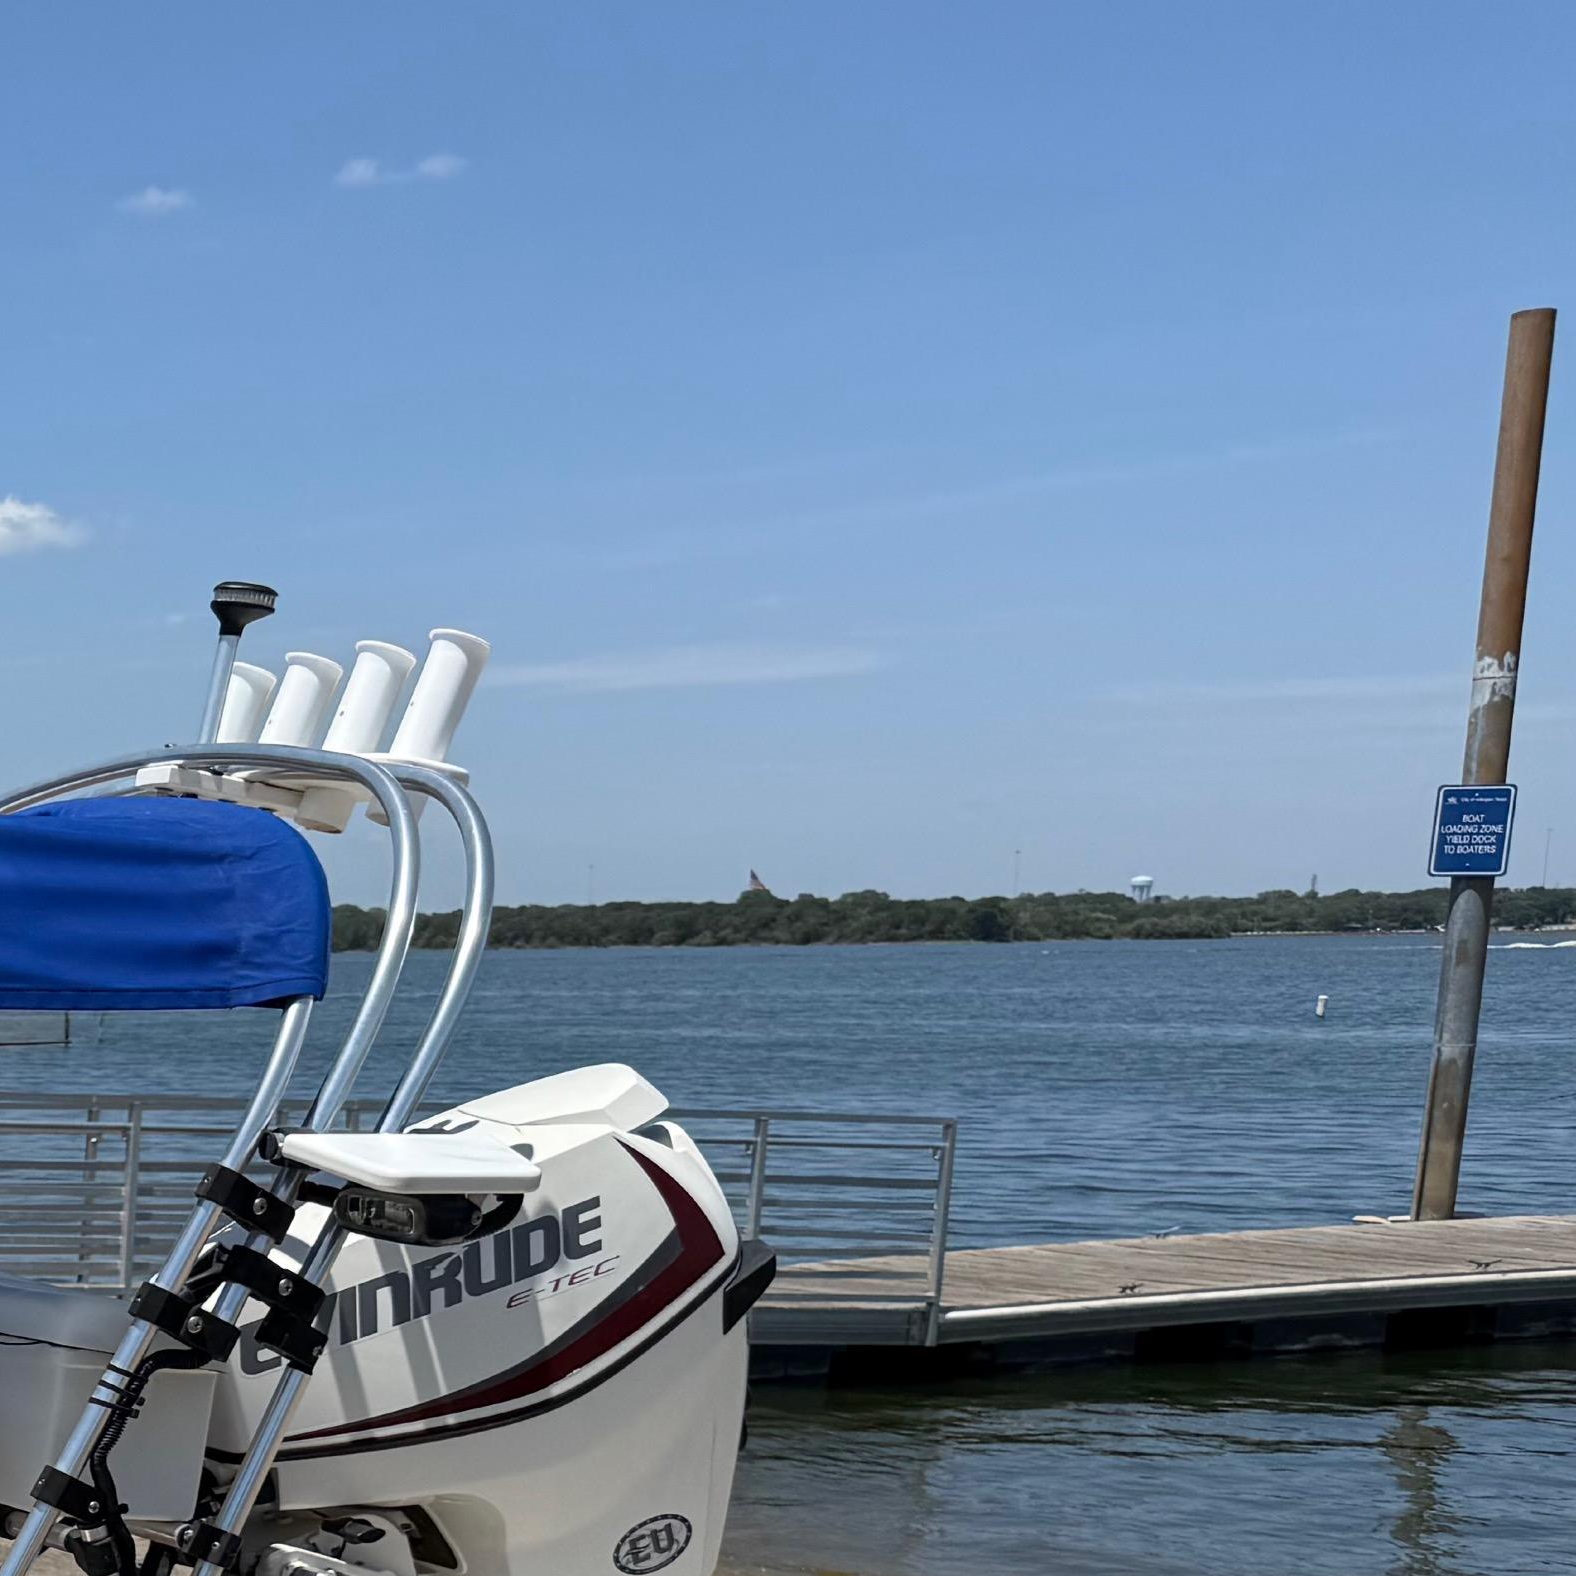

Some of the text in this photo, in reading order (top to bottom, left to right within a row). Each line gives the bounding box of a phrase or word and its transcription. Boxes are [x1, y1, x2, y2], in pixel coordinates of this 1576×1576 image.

[1462, 814, 1485, 823] BOAT
[1441, 824, 1504, 834] LOADING ZONE
[1446, 835, 1497, 843] YIELD DOCK
[1444, 845, 1497, 854] TO BOATERS
[506, 1254, 620, 1309] E-TEC
